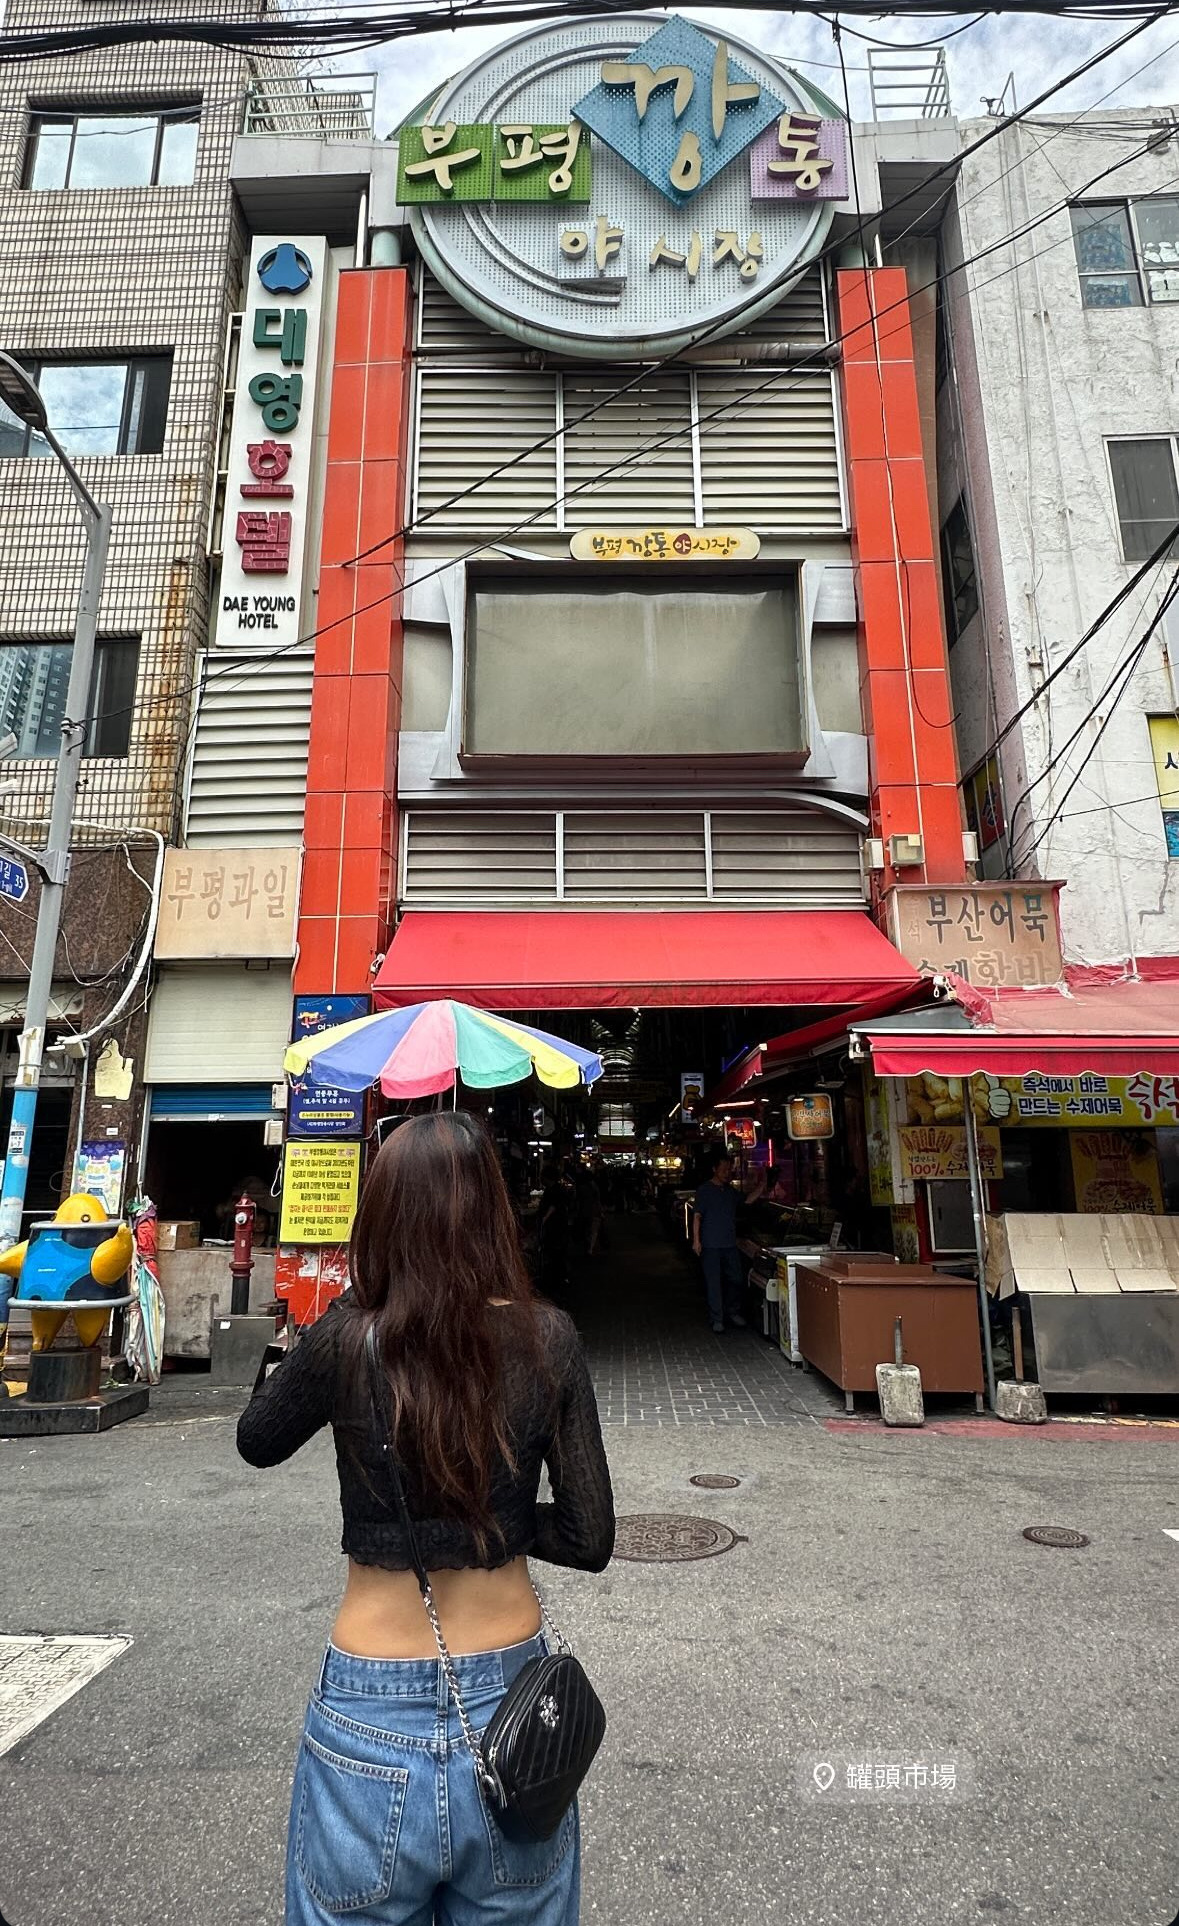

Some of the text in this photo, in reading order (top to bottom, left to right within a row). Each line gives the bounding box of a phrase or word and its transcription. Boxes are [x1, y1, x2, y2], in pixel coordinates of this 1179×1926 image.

[404, 39, 835, 196] 부평 깡통
[236, 308, 308, 576] 대영호텔
[592, 532, 738, 558] 부평 깡통 야시장
[223, 596, 296, 612] DAE YOUNG
[238, 613, 278, 629] HOTEL
[0, 861, 12, 880] 길
[15, 875, 23, 889] 35
[167, 865, 288, 920] 부평과일
[926, 891, 1049, 944] 부산어묵
[1023, 1076, 1108, 1093] 즉석에서 바로
[1018, 1097, 1123, 1115] 만드는 수제어묵
[909, 1158, 997, 1177] 100% 수제묵
